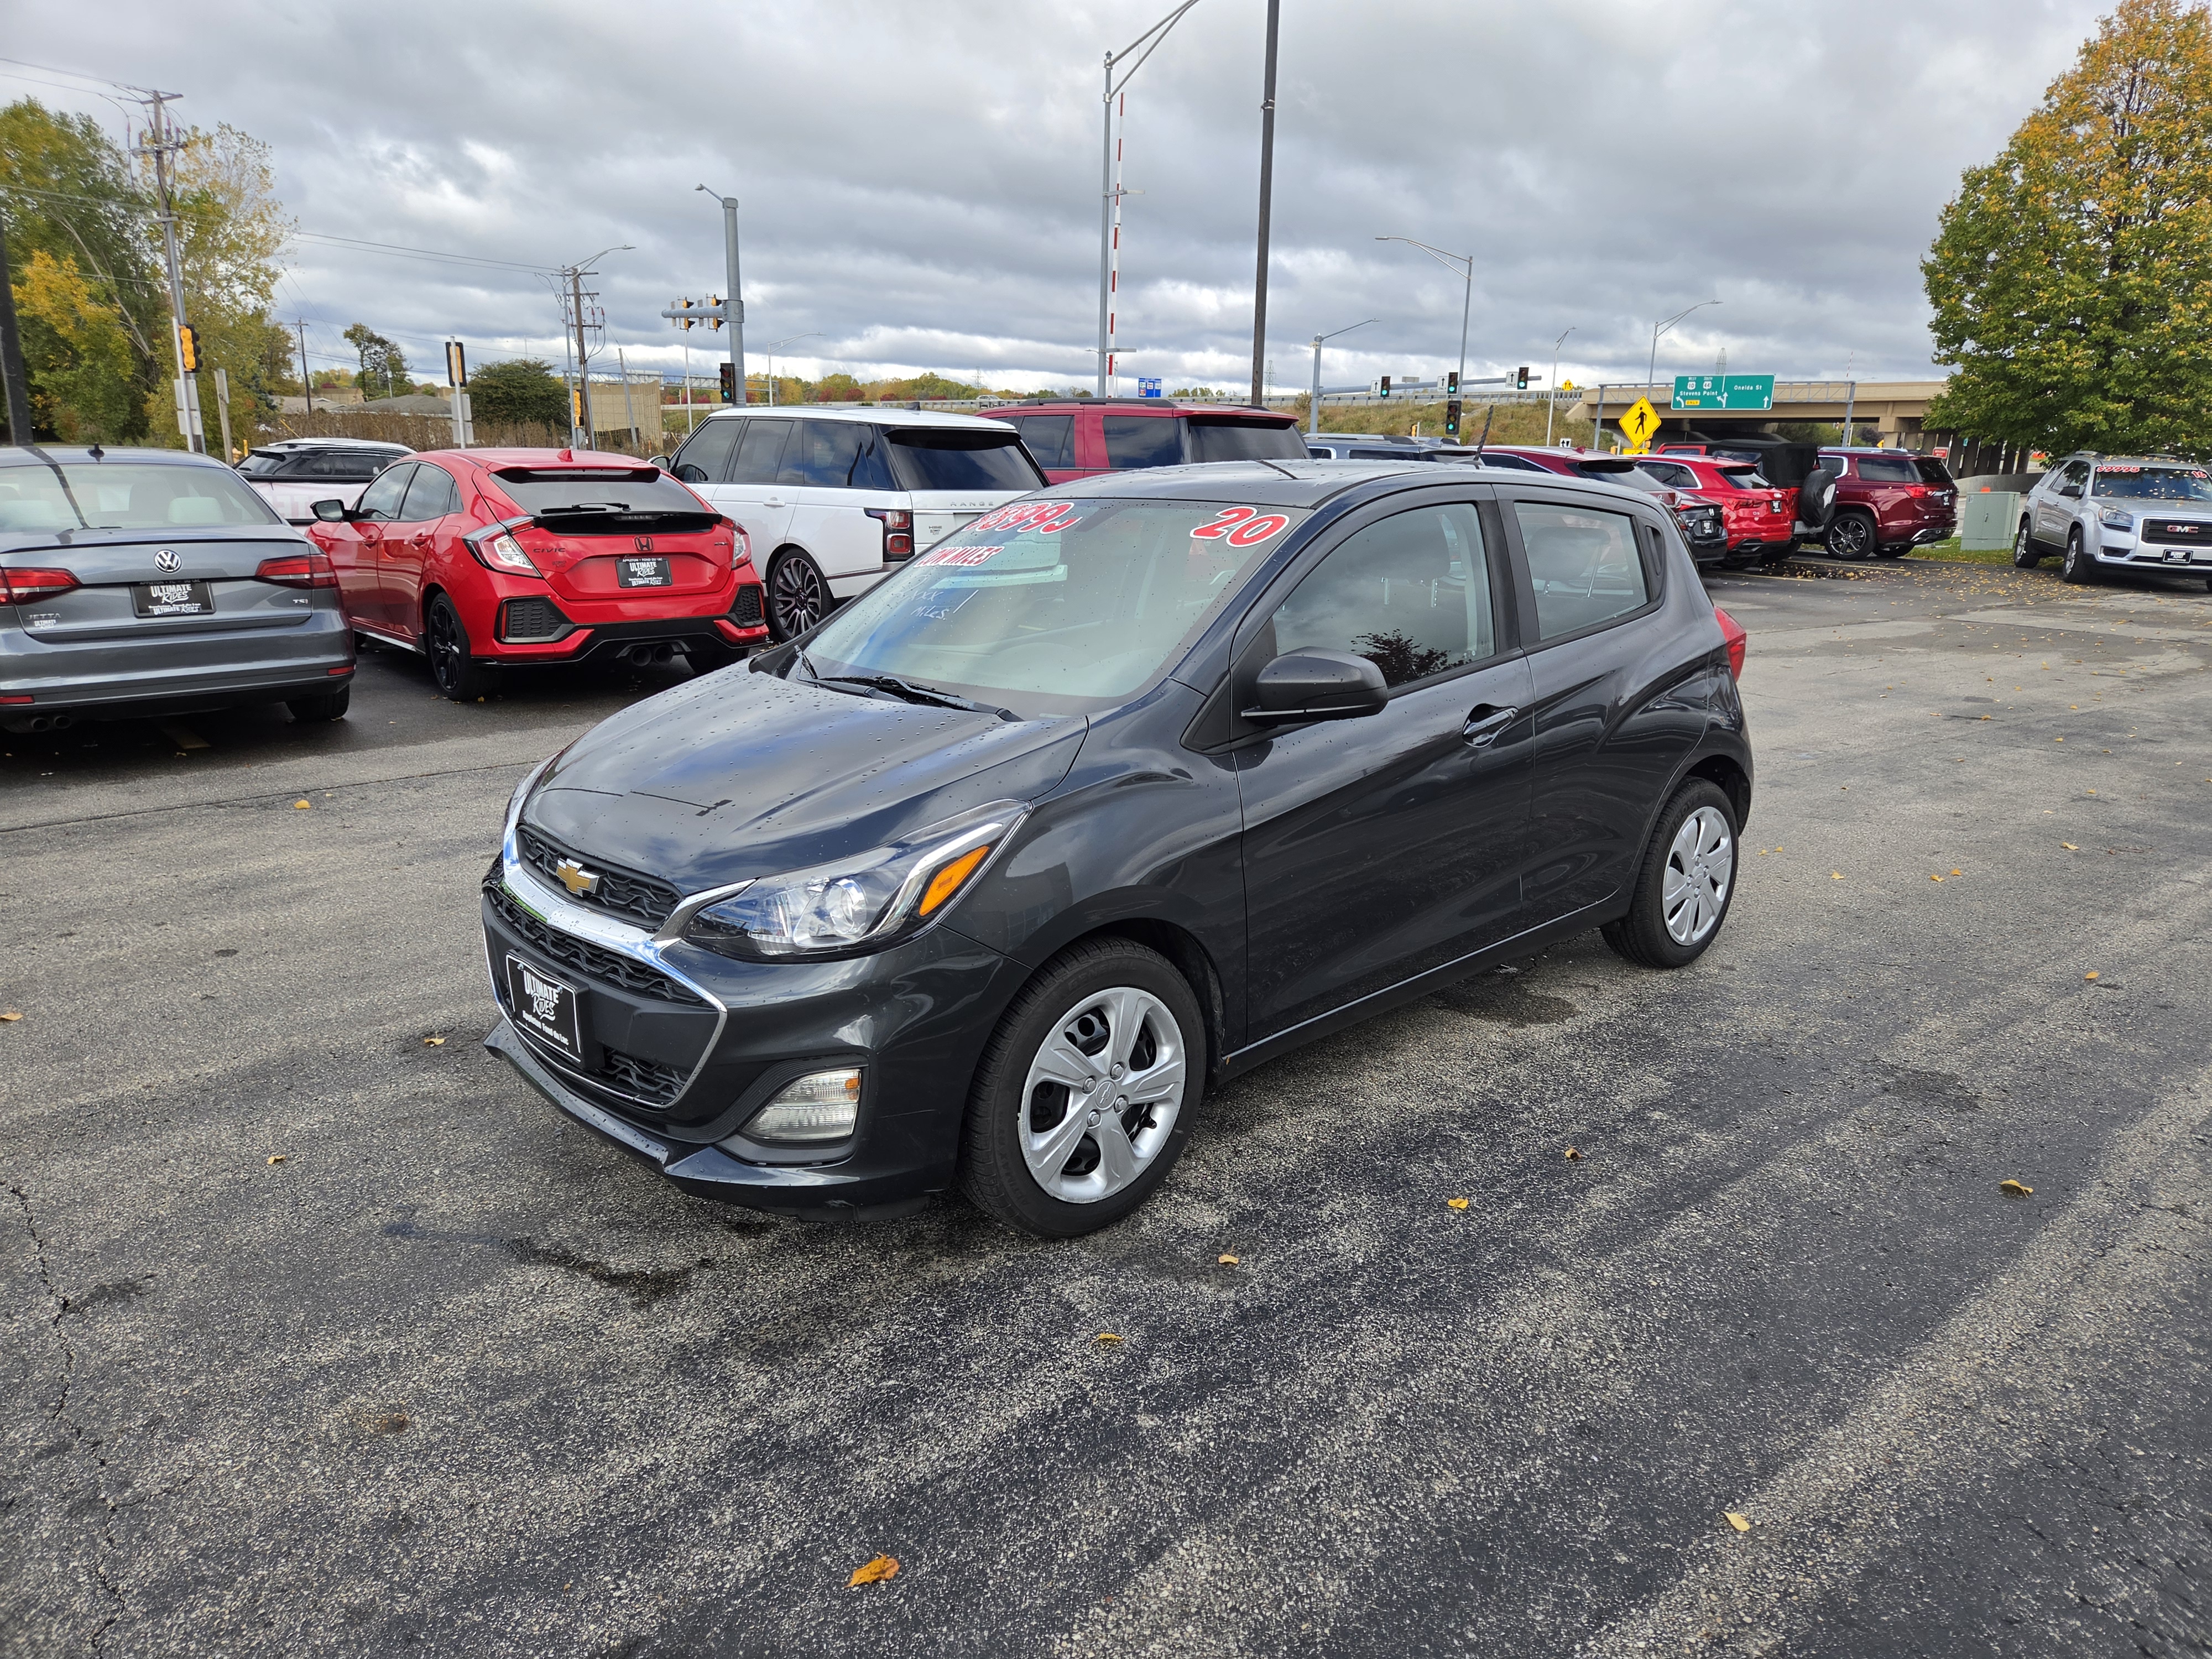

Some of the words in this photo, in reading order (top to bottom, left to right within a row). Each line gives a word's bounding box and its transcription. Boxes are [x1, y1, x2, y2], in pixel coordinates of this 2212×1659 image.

[2192, 471, 2208, 479] 16
[1190, 506, 1290, 547] 20
[2167, 525, 2199, 534] GMC
[913, 546, 961, 568] LOW
[942, 546, 1005, 567] MILES
[629, 562, 657, 572] ULTIMATE
[150, 584, 192, 598] ULTIMATE
[524, 970, 559, 1004] ULTIMATE
